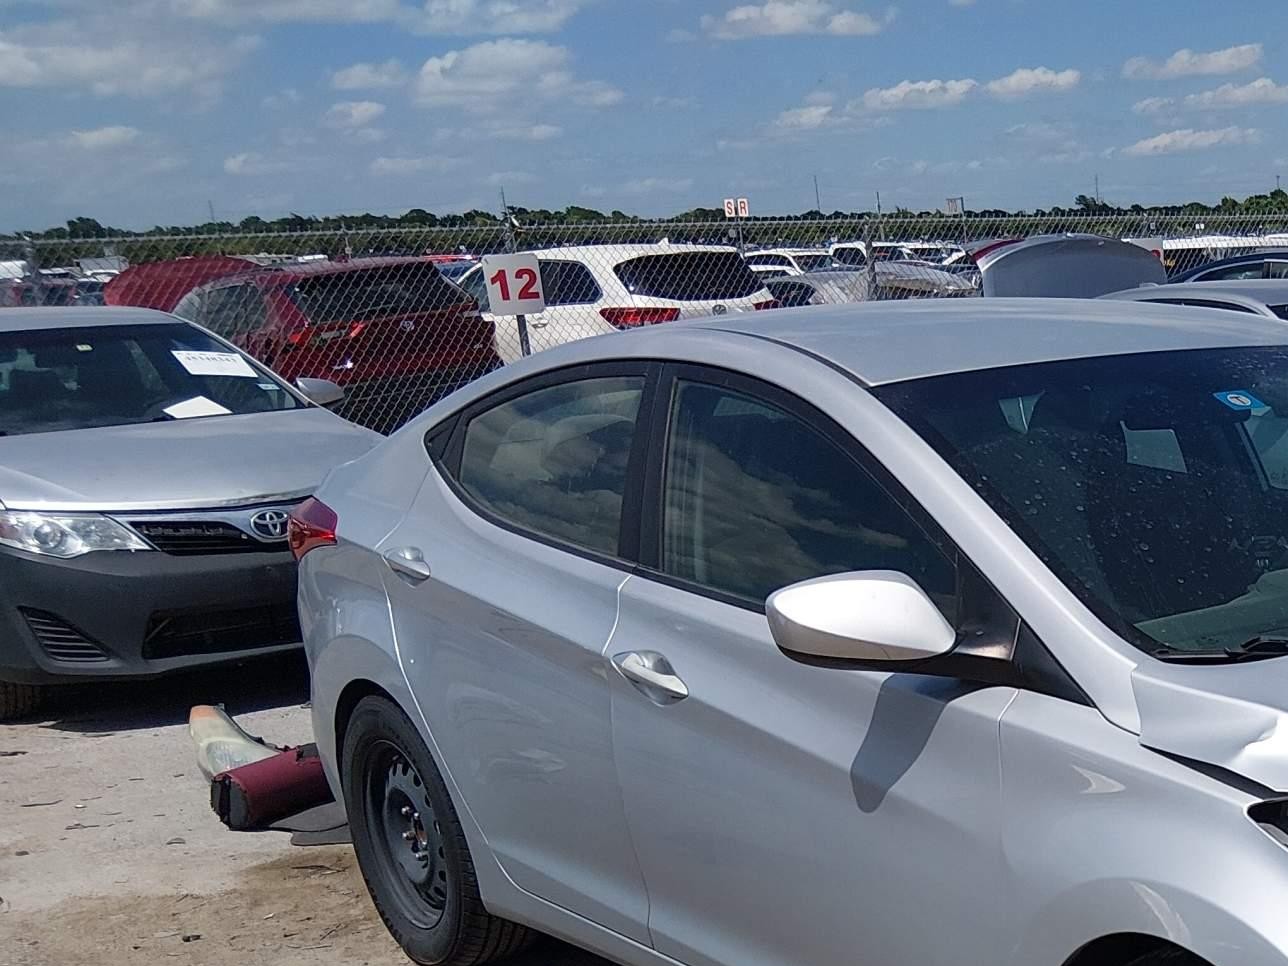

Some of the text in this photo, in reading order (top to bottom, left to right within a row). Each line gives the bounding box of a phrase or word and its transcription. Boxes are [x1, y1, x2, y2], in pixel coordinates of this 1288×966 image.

[726, 201, 733, 215] S
[739, 201, 747, 215] R
[490, 268, 541, 301] 12
